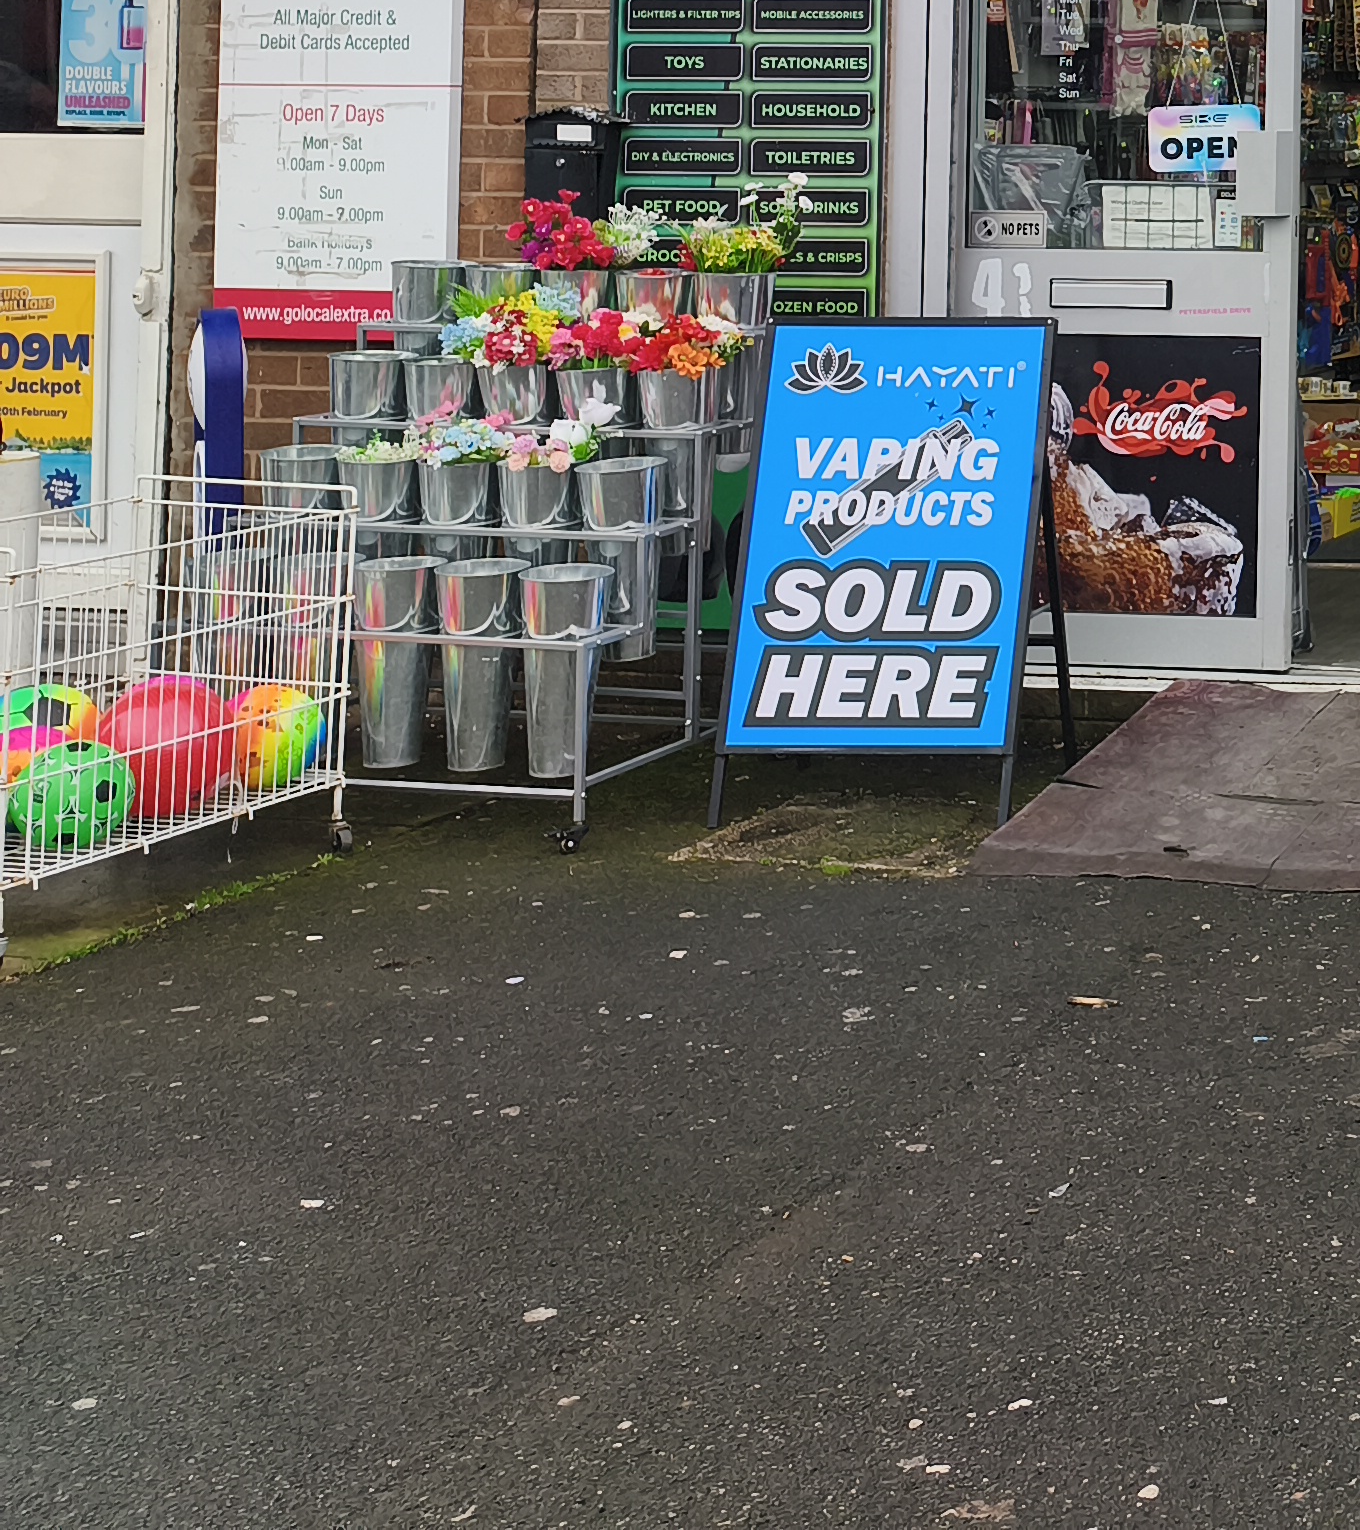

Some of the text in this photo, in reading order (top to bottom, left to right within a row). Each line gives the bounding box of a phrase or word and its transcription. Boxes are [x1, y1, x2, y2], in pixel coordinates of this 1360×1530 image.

[273, 9, 396, 28] All Major Credit &
[632, 10, 677, 19] LIGHTERS
[688, 10, 718, 19] FILTER
[720, 10, 741, 19] TIPS
[761, 10, 864, 20] MOBILE ACCESSORIES
[1059, 10, 1079, 19] Tue
[1059, 26, 1082, 35] Wed
[260, 33, 410, 53] Debit Cards Accepted
[1059, 41, 1079, 51] Thu
[665, 56, 704, 69] TOYS
[760, 57, 868, 70] STATIONARIES
[1059, 57, 1073, 67] Fri
[65, 66, 112, 80] DOUBLE
[1059, 72, 1076, 82] Sat
[65, 81, 127, 95] FLAVOURS
[1059, 88, 1079, 98] Sun
[65, 95, 131, 109] UNLEASHED
[283, 104, 385, 126] Open 7 Days
[650, 103, 717, 116] KITCHEN
[761, 104, 861, 117] HOUSEHOLD
[303, 136, 363, 151] Mon Sat
[631, 152, 650, 162] DIY
[662, 152, 735, 162] ELECTRONICS
[766, 152, 855, 165] TOILETRIES
[338, 158, 385, 174] 9.00pm
[319, 186, 343, 200] Sun
[643, 200, 721, 213] PET FOOD
[277, 206, 323, 222] 9.00am
[1001, 222, 1040, 236] NO PETS
[818, 253, 862, 263] CRISPS
[335, 257, 382, 274] 7.00pm
[816, 301, 858, 313] FOOD
[877, 366, 1015, 388] HAYATI
[5, 377, 81, 397] Jackpot
[22, 407, 68, 419] February
[795, 437, 1000, 480] VAPING
[785, 490, 994, 526] PRODUCTS
[765, 568, 993, 634] SOLD
[755, 654, 987, 718] HERE
